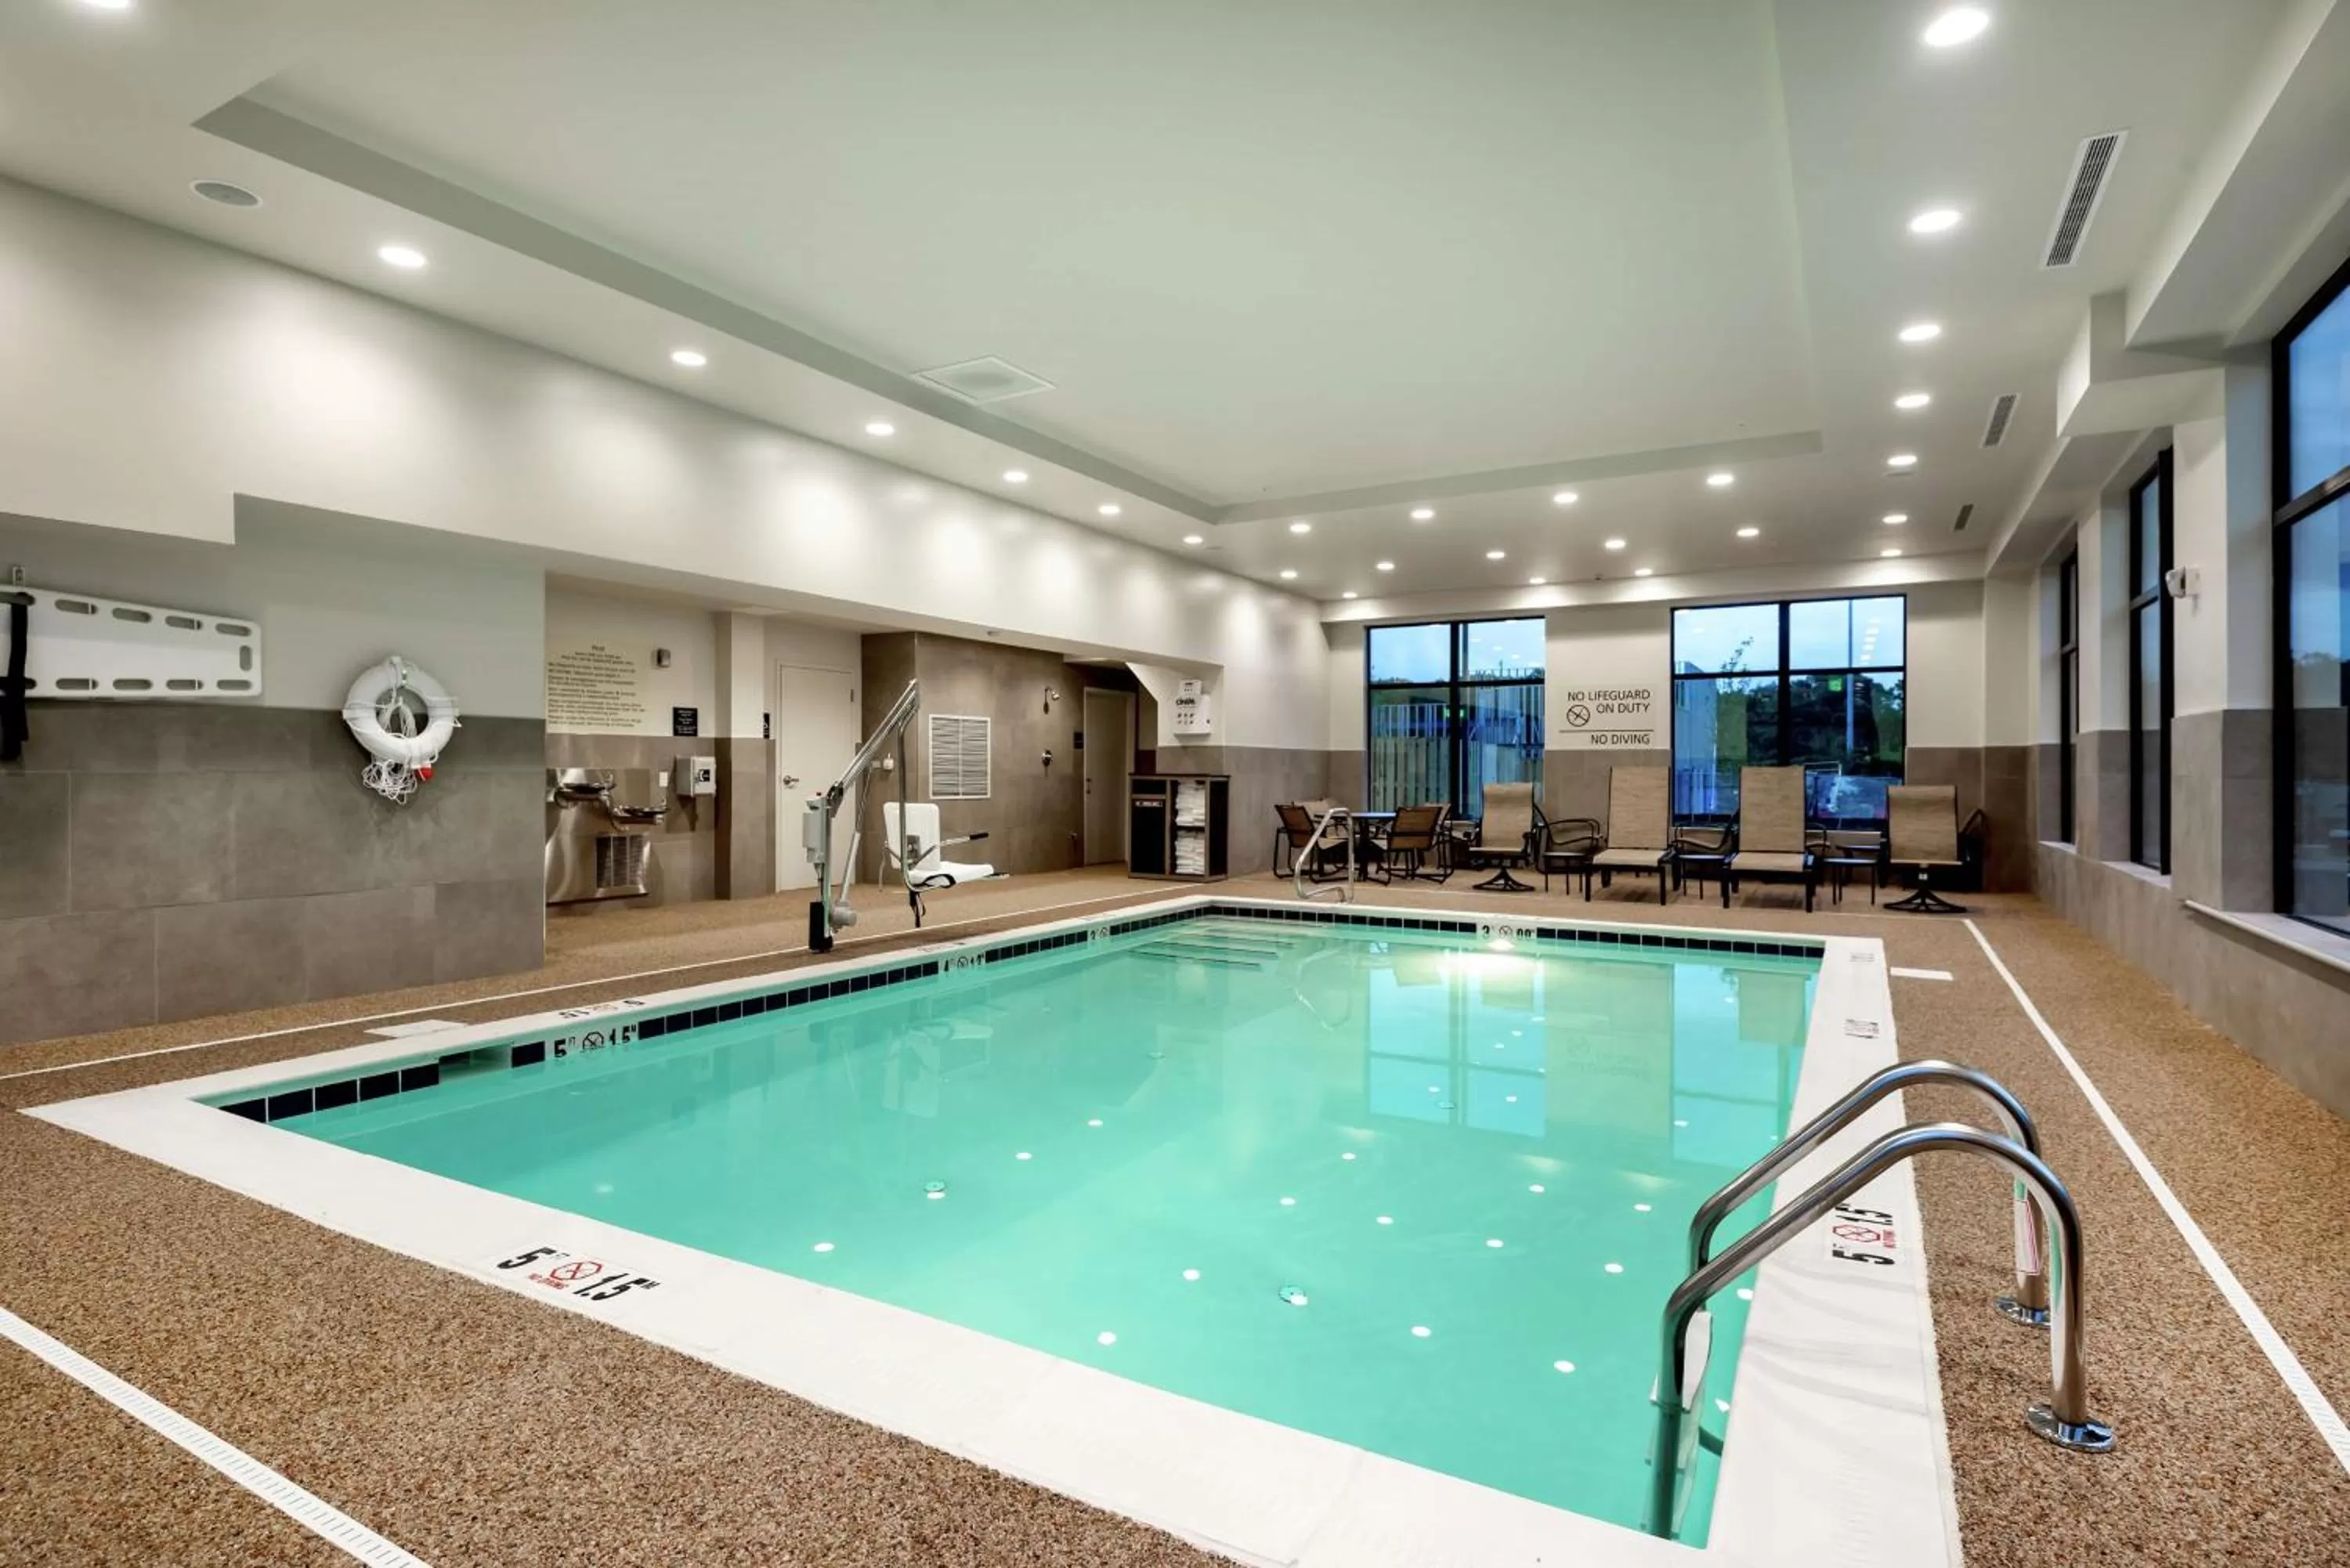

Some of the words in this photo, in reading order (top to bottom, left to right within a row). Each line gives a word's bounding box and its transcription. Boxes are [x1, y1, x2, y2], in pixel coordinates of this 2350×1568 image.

[1567, 692, 1585, 701] NO
[1588, 689, 1650, 701] LIFEGUARD
[1596, 703, 1614, 714] ON
[1618, 703, 1650, 714] DUTY
[1591, 734, 1608, 745] NO
[1611, 734, 1650, 744] DIVING
